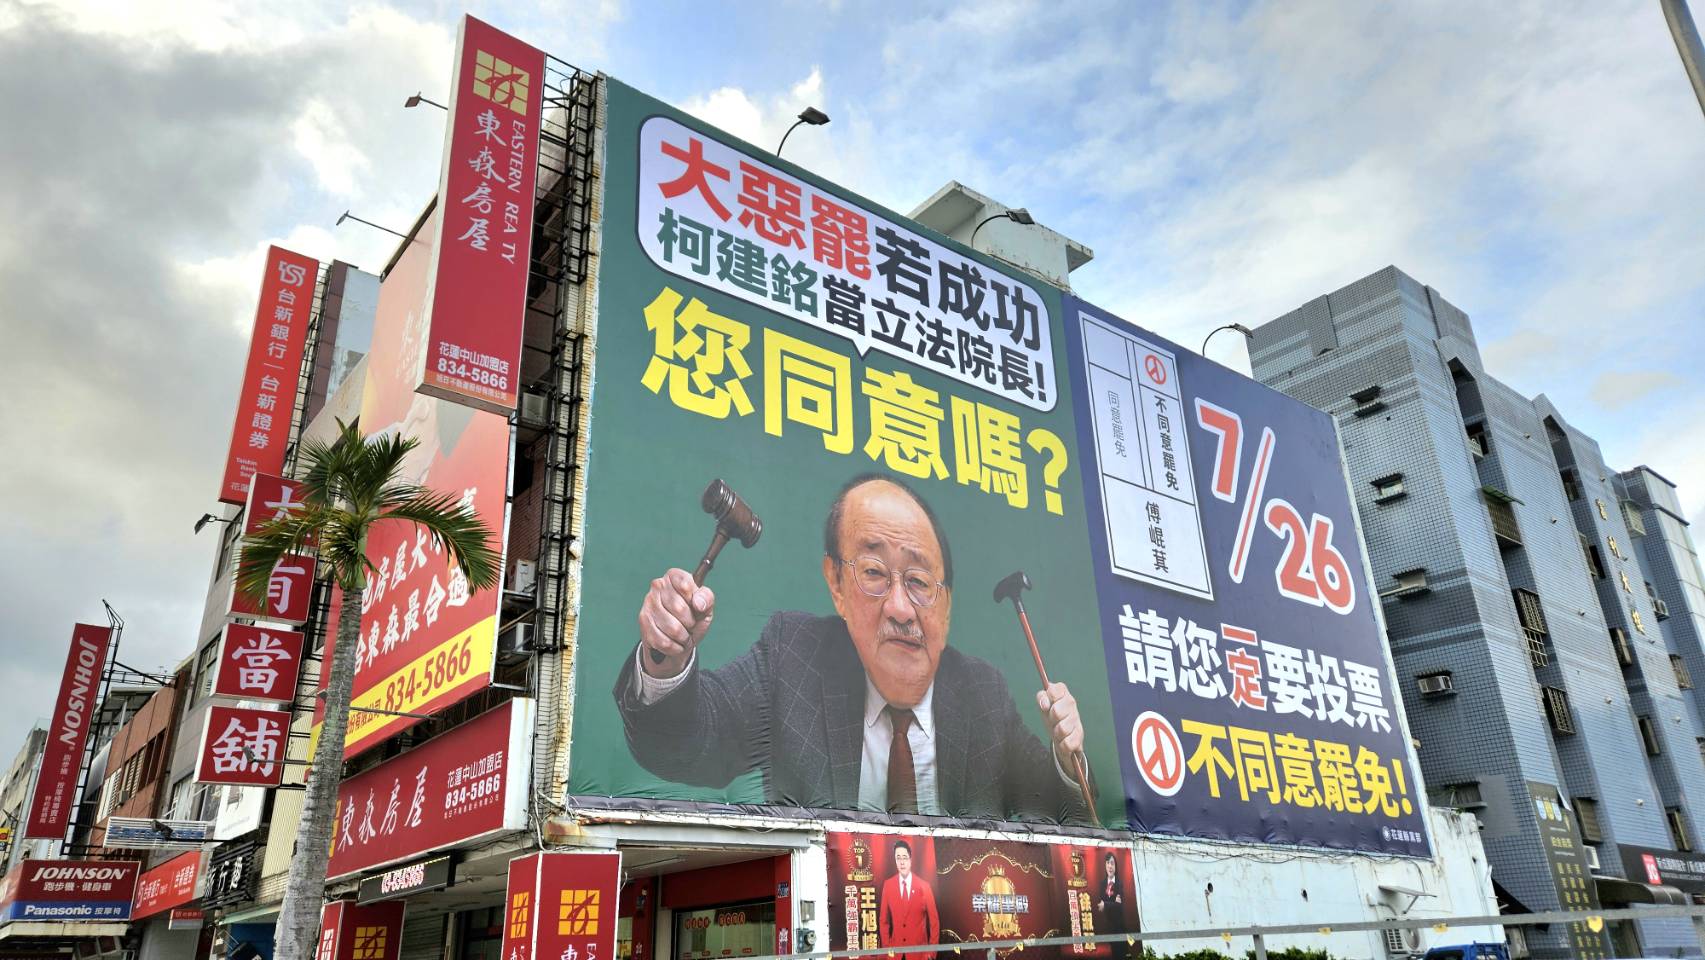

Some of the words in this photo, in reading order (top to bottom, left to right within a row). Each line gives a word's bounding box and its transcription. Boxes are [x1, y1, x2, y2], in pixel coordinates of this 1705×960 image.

[458, 109, 507, 251] 東森房屋
[507, 119, 526, 193] EASTERN
[658, 138, 1040, 351] 大惡罷若成功
[657, 207, 1047, 403] 柯建銘當立法院長!
[437, 357, 508, 390] 834-5866
[440, 342, 509, 375] 花蓮中山加盟店
[641, 286, 1068, 516] 您同意嗎?
[1107, 390, 1127, 458] 同意罷免
[1154, 395, 1179, 491] 不同意罷免
[1145, 501, 1169, 574] 傅崐萁
[1195, 396, 1356, 615] 7/26
[60, 637, 98, 746] JOHNSON
[384, 635, 472, 717] 834-5866
[1118, 604, 1392, 734] 請您一定要投票
[338, 766, 428, 853] 東森房屋
[445, 773, 501, 809] 834-5866
[447, 751, 503, 789] 花蓮中山加盟店
[1181, 718, 1413, 818] 不同意罷免!
[25, 904, 92, 915] Panasonic
[30, 867, 126, 882] JOHNSON
